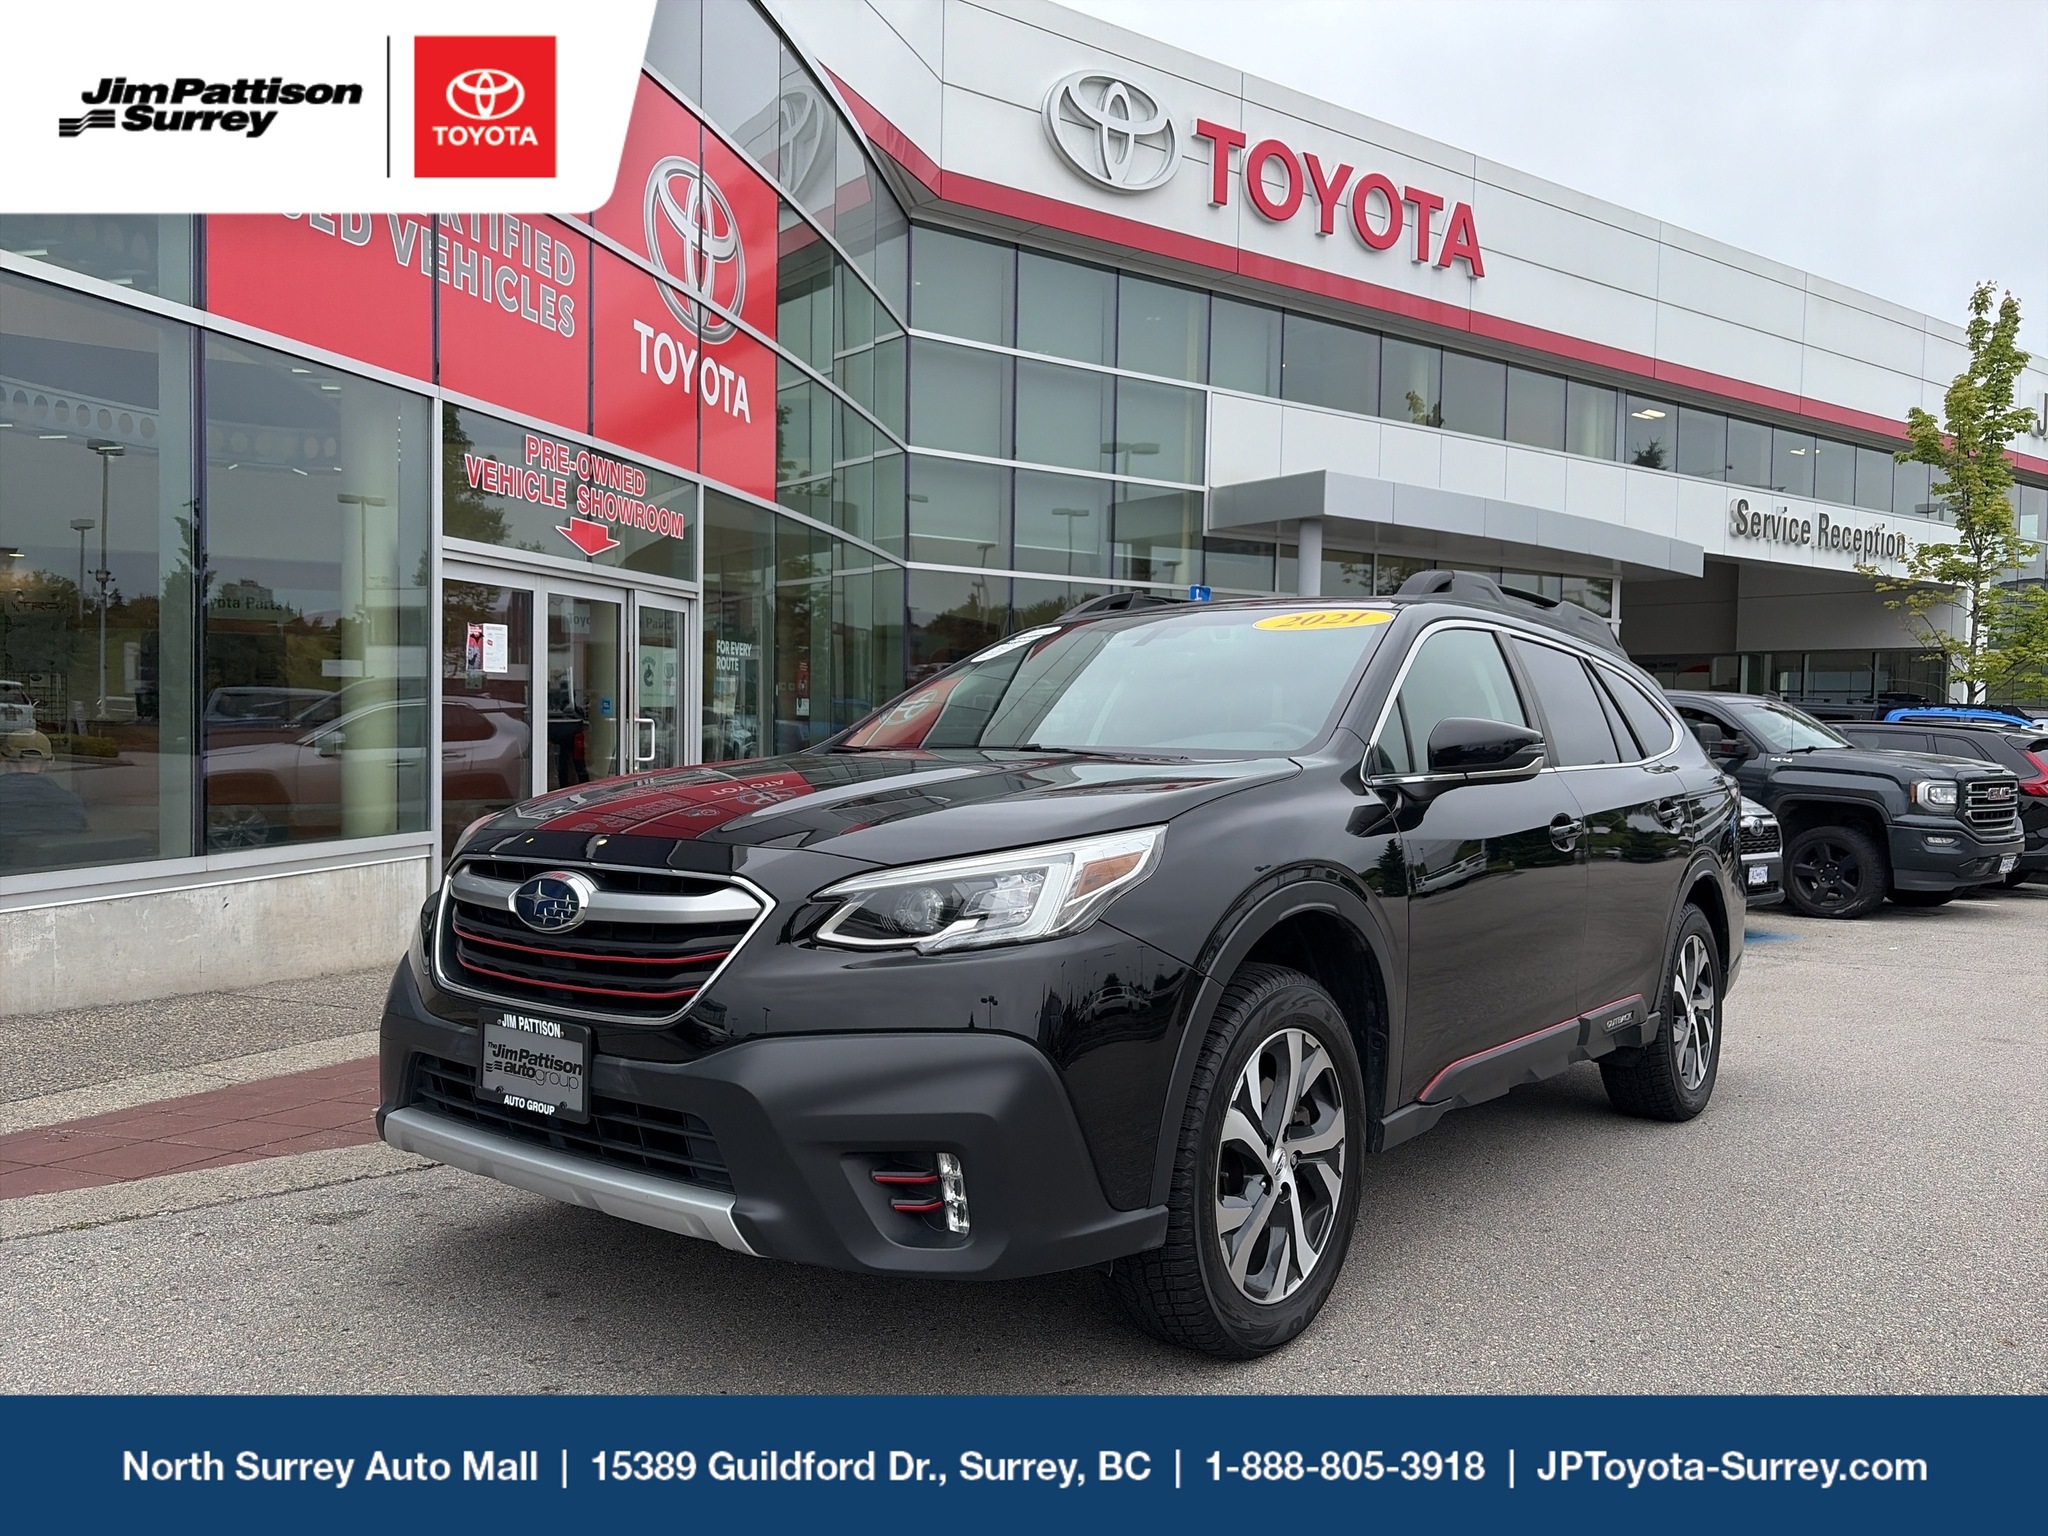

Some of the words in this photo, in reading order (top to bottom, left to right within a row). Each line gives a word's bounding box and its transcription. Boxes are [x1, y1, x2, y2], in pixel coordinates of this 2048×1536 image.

[1192, 118, 1486, 279] TOYOTA
[388, 213, 575, 337] VEHICLES
[633, 318, 751, 424] TOYOTA
[525, 433, 646, 497] PRE-OWNED
[464, 453, 567, 509] VEHICLE
[576, 484, 684, 540] SHOWROOM
[1731, 498, 1811, 545] Service
[1817, 511, 1906, 563] Reception
[1274, 612, 1369, 628] 2021
[716, 639, 730, 654] FOR
[731, 641, 752, 657] EVERY
[716, 655, 739, 671] ROUTE
[1987, 787, 2011, 800] GMC
[501, 1013, 517, 1029] JIM
[518, 1016, 561, 1038] PATTISON
[487, 1041, 498, 1050] The
[503, 1094, 526, 1109] AUTO
[526, 1099, 555, 1115] GROUP
